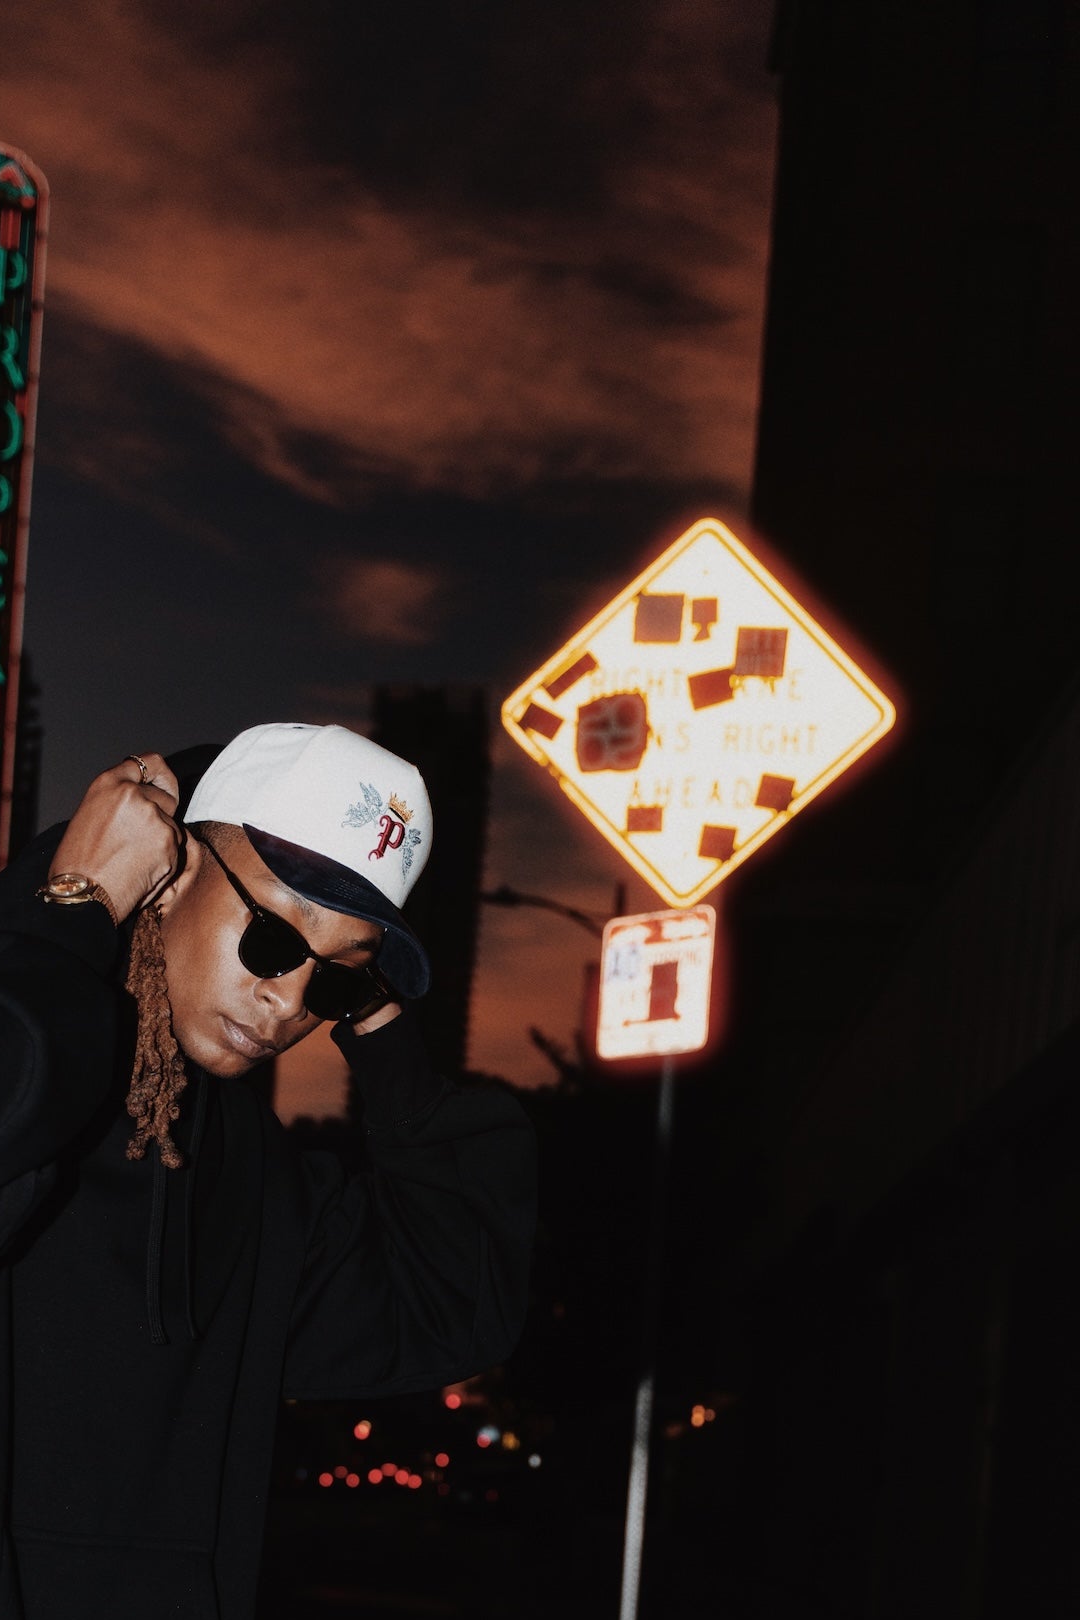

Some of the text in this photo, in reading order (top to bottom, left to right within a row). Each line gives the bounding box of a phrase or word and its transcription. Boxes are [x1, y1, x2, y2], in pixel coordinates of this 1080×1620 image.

[589, 667, 685, 698] RIGHT
[723, 723, 817, 754] RIGHT
[629, 776, 752, 809] AHEAD
[369, 815, 406, 861] P
